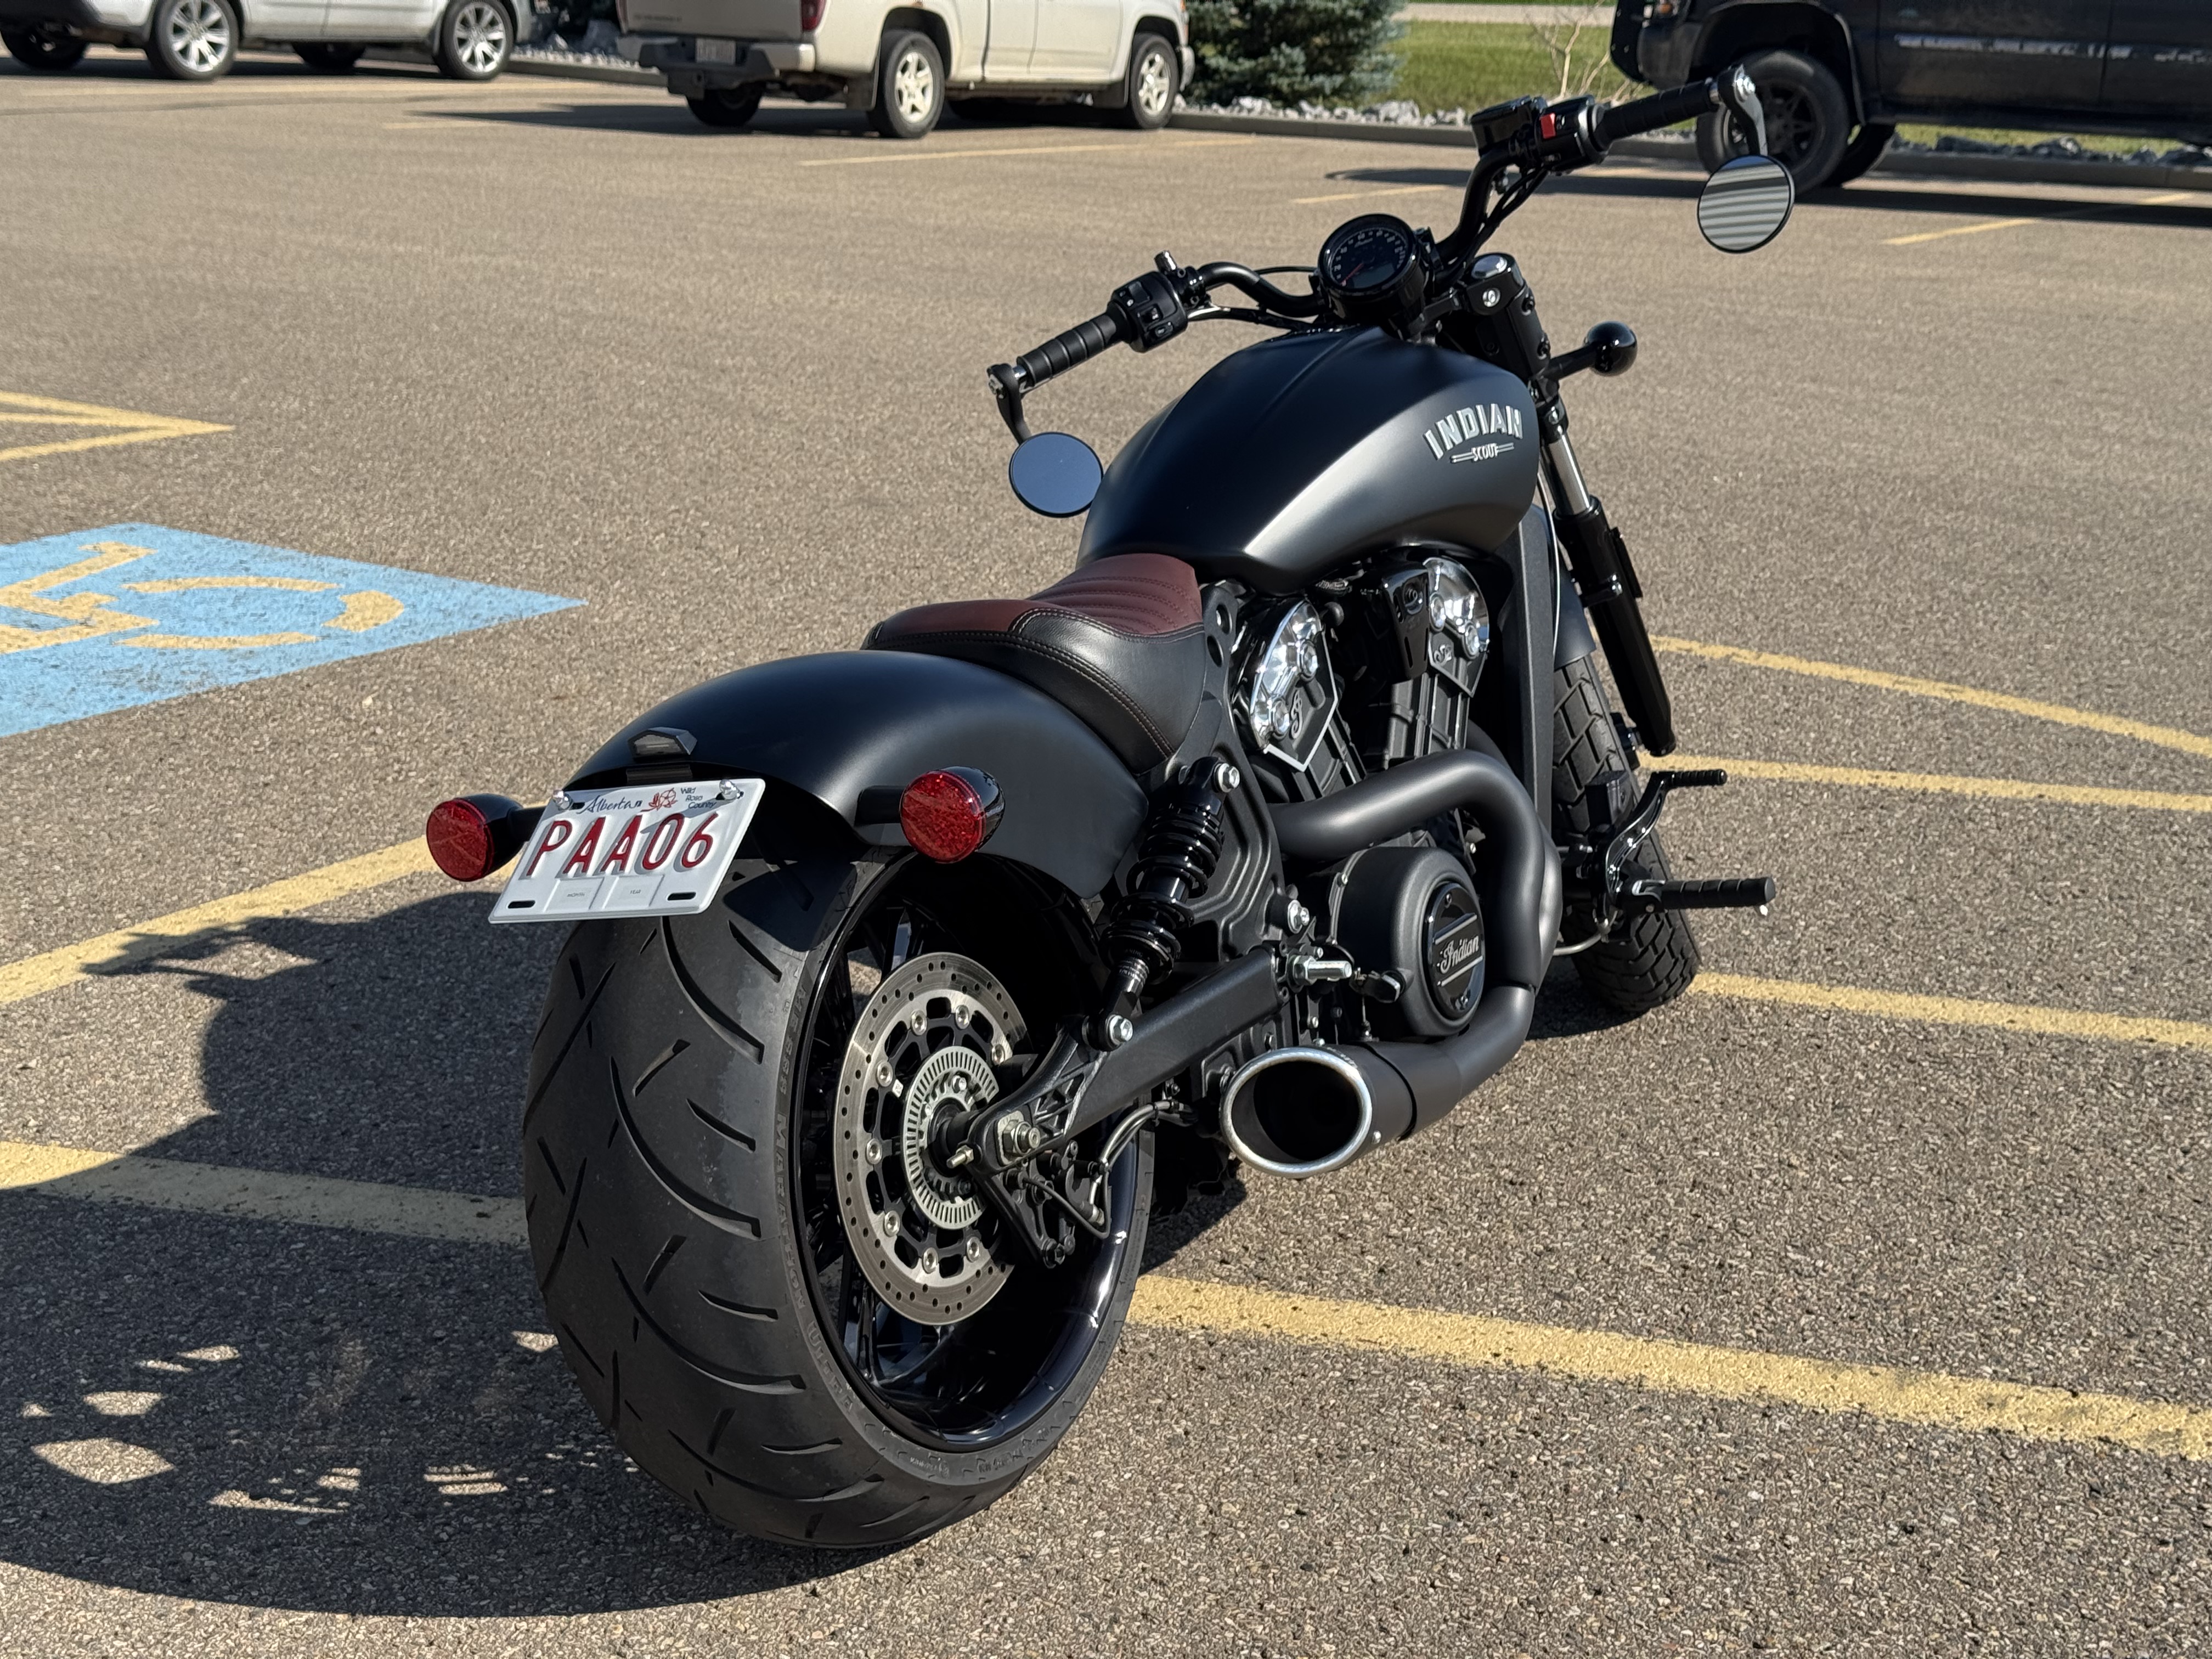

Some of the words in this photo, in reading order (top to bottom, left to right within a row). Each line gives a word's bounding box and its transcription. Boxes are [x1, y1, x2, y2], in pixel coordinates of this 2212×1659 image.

[1423, 403, 1523, 460] INDIAN
[1471, 443, 1499, 462] SCOUT
[576, 795, 636, 814] Alberta
[526, 811, 719, 877] PAA06
[1440, 935, 1480, 974] Indian
[775, 1113, 806, 1310] MARATHON
